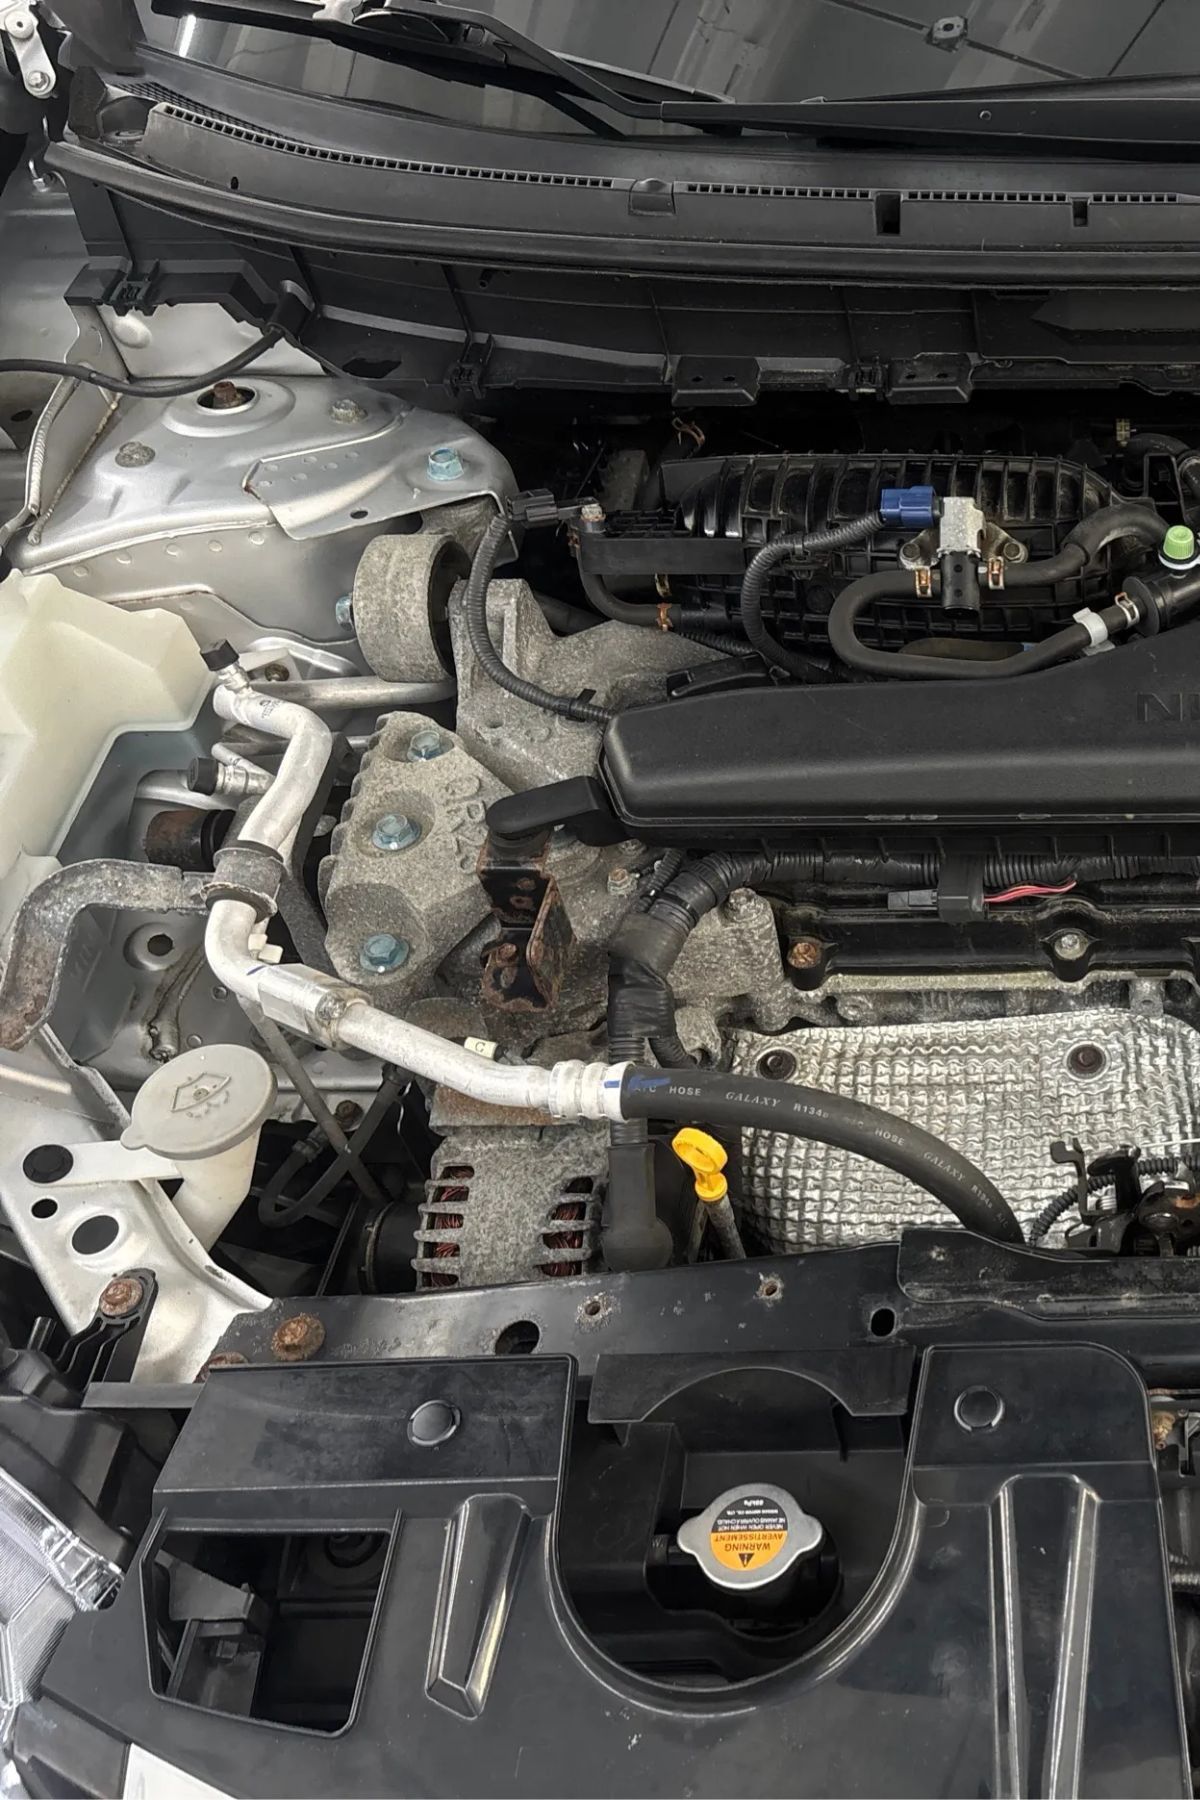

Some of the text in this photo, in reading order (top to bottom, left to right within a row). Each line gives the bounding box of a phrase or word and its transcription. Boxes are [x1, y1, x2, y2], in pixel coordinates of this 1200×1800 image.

[669, 1086, 702, 1096] HOSE
[726, 1092, 782, 1108] GALAXY
[875, 1128, 906, 1146] HOSE
[924, 1151, 966, 1182] GALAXY
[715, 1533, 783, 1542] AVERTISSEMENT
[724, 1542, 771, 1551] WARNING
